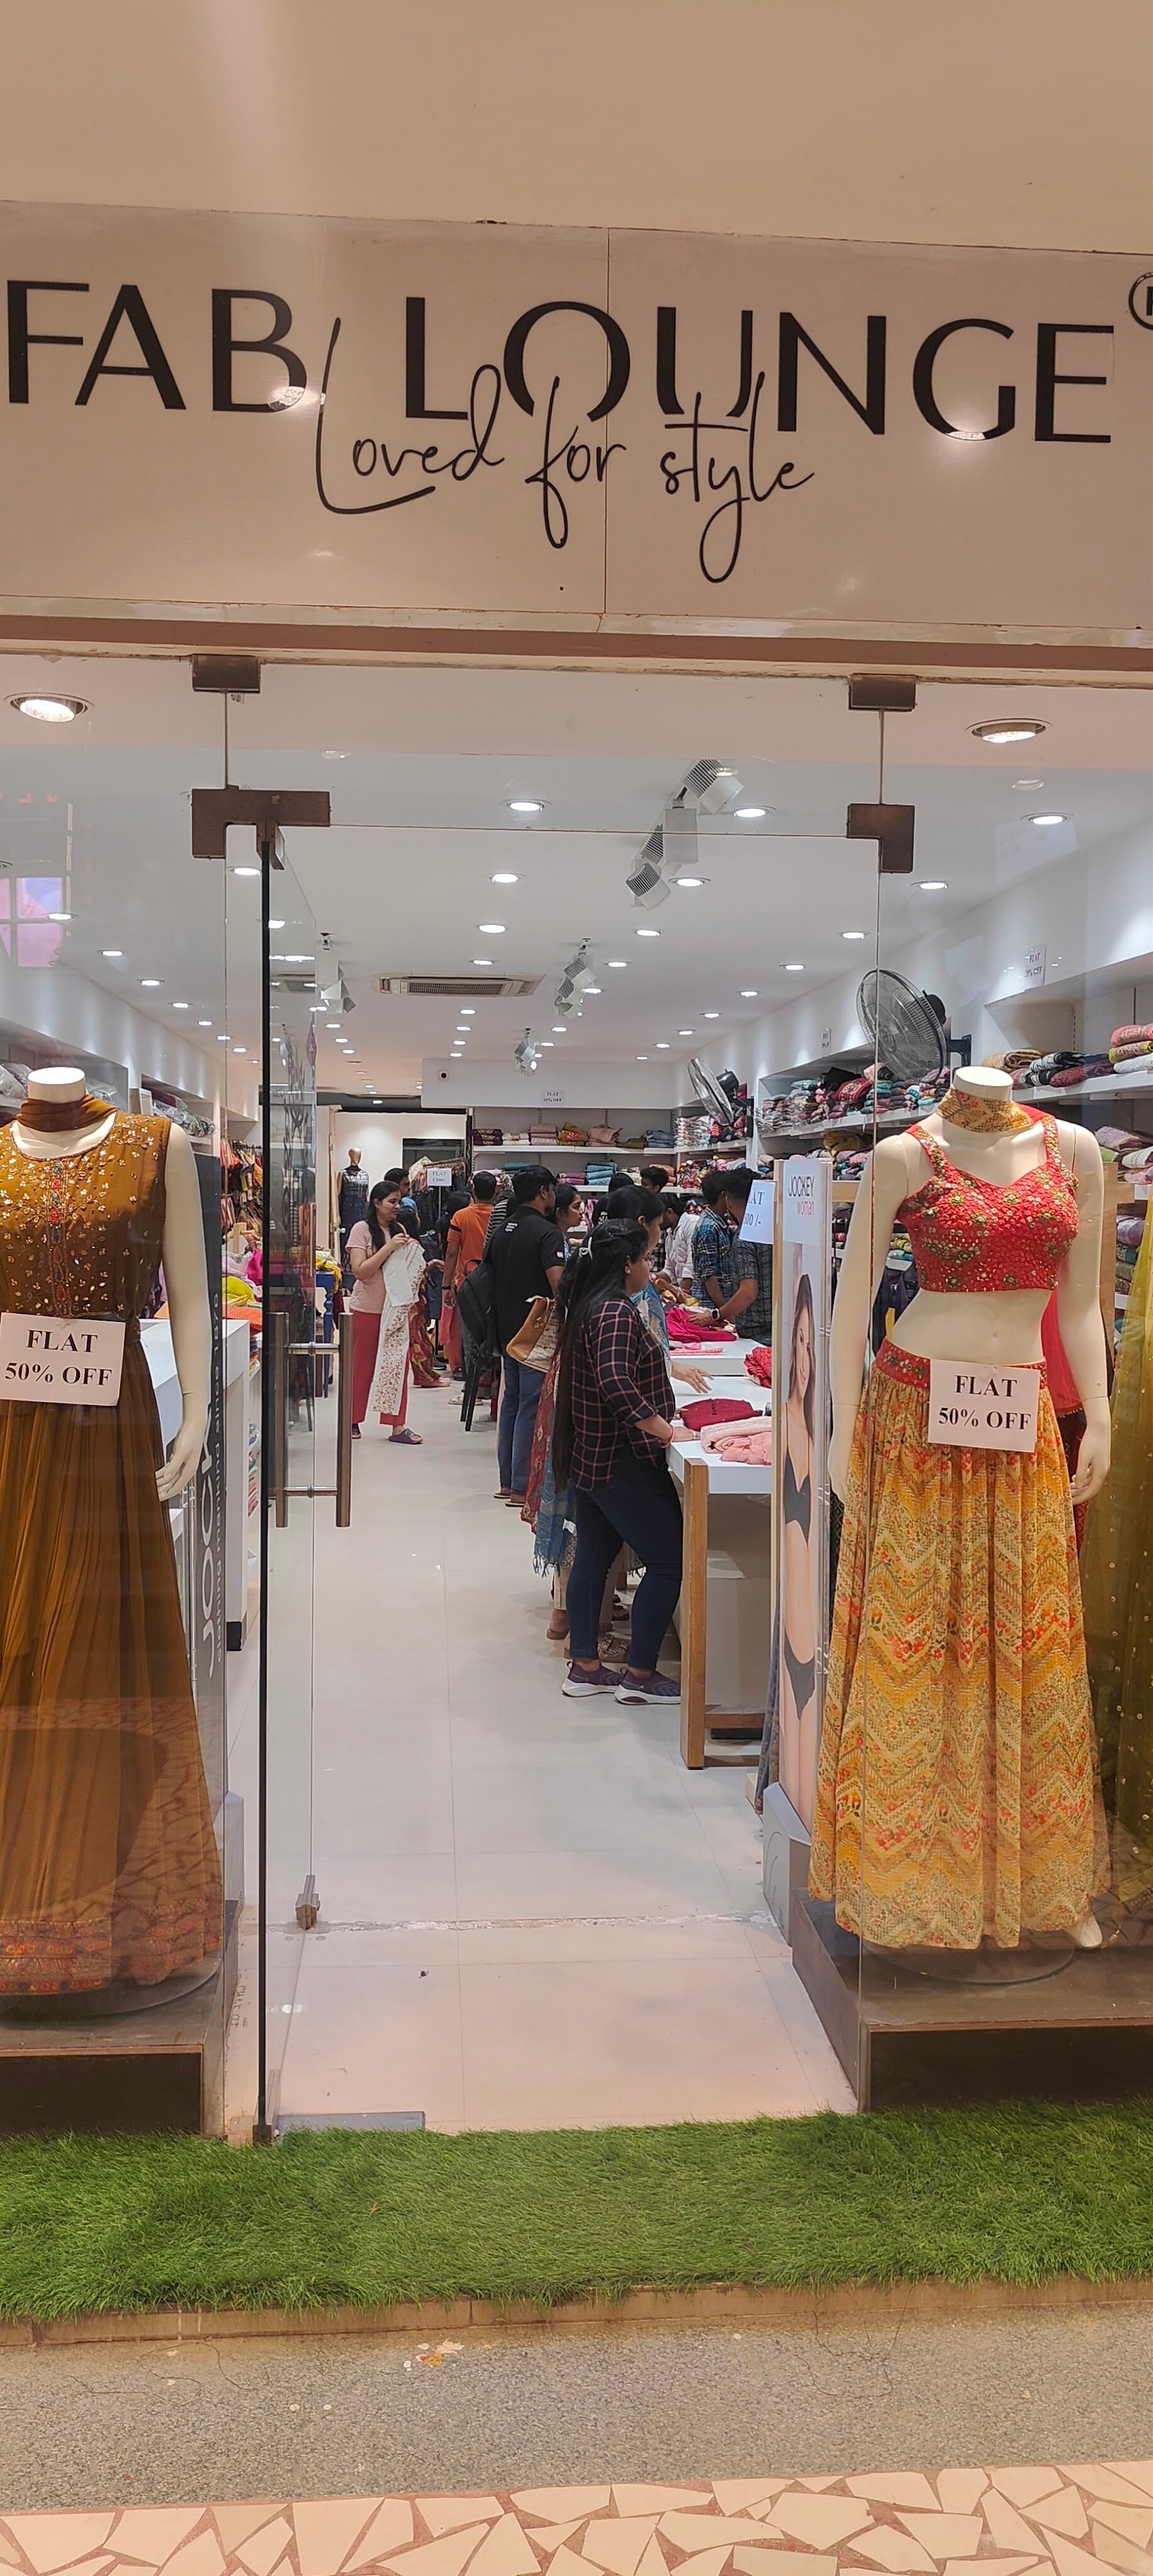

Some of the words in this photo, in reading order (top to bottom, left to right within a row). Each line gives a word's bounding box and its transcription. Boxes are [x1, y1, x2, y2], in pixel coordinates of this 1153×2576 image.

[7, 280, 308, 412] FAB
[405, 296, 1114, 443] LOUNGE
[315, 317, 505, 515] Loved
[525, 375, 627, 549] for
[660, 371, 815, 583] style
[748, 1191, 765, 1205] AT
[788, 1176, 815, 1197] JOCKEY
[796, 1201, 815, 1215] woman
[25, 1329, 98, 1353] FLAT
[5, 1362, 53, 1383] 50%
[62, 1366, 113, 1386] OFF
[954, 1374, 1018, 1397] FLAT
[938, 1407, 979, 1427] 50%
[986, 1411, 1032, 1430] OFF
[202, 1403, 215, 1679] JOCK
